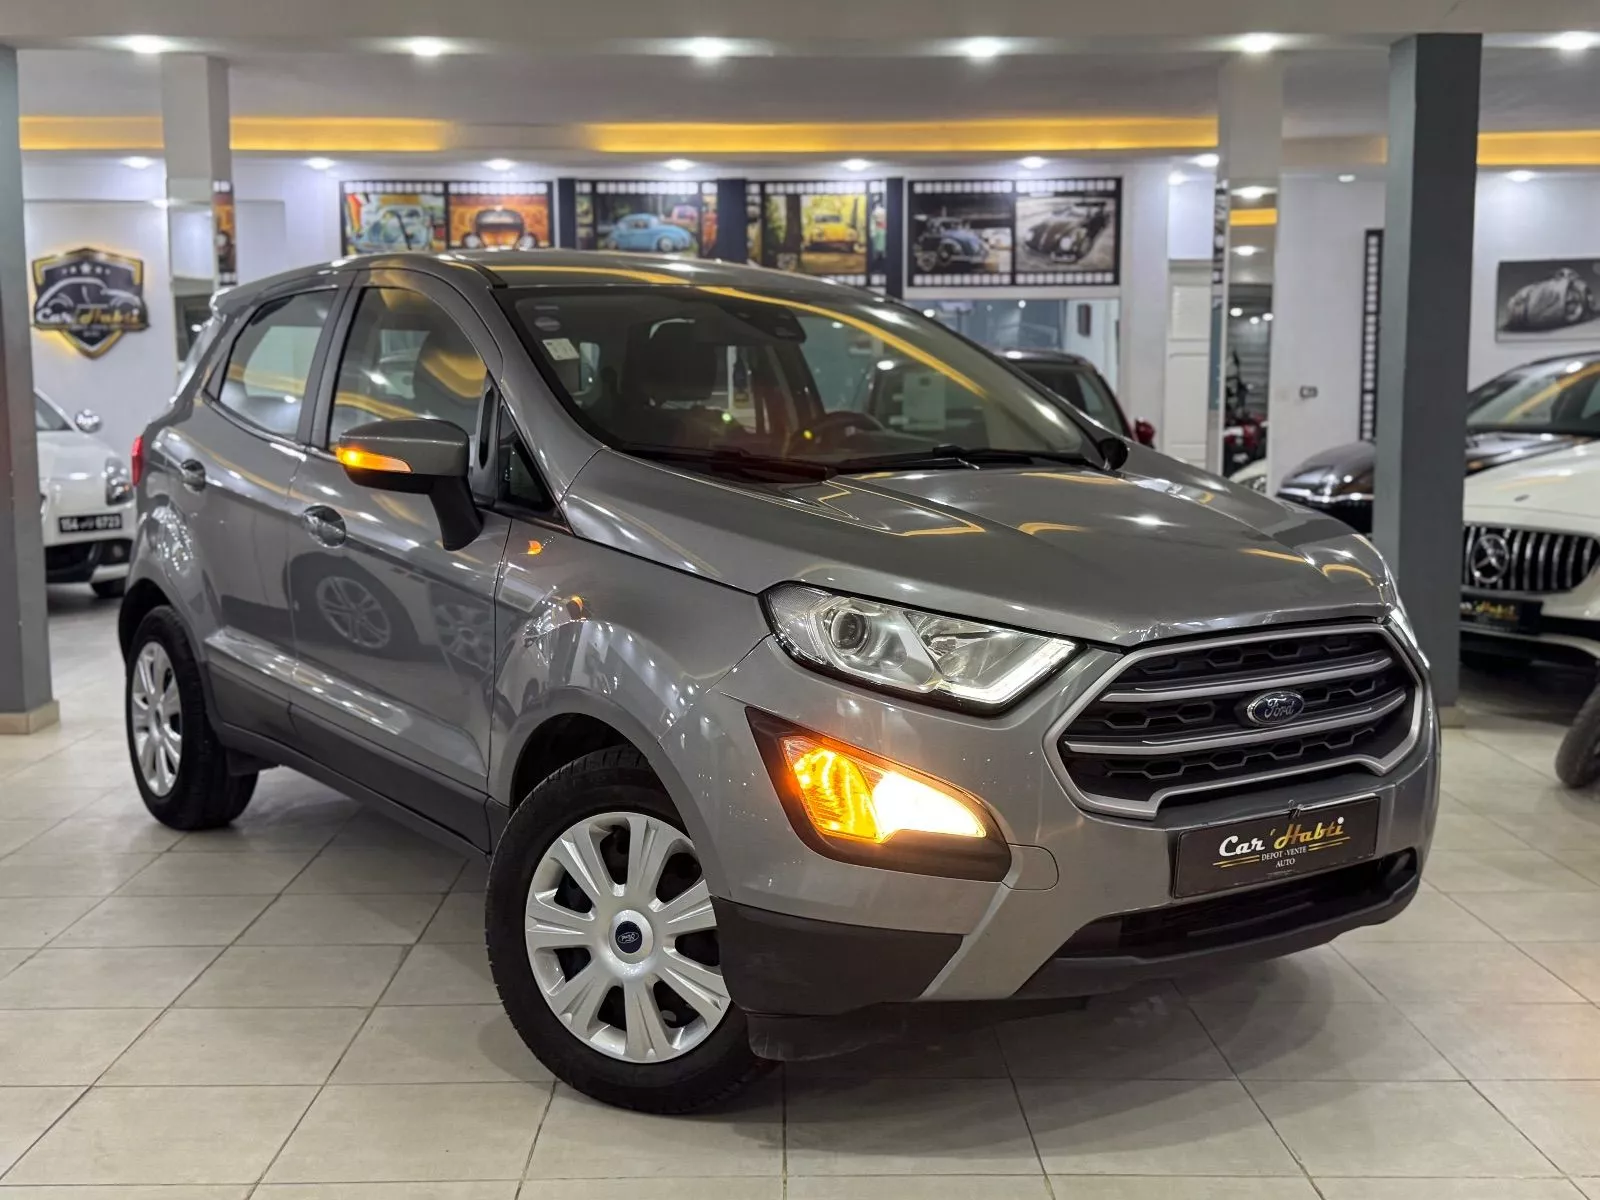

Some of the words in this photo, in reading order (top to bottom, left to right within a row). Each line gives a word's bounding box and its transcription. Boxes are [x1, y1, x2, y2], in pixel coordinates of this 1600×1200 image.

[1264, 698, 1295, 719] Ford
[1219, 835, 1265, 856] Car
[1275, 857, 1296, 869] AUTO
